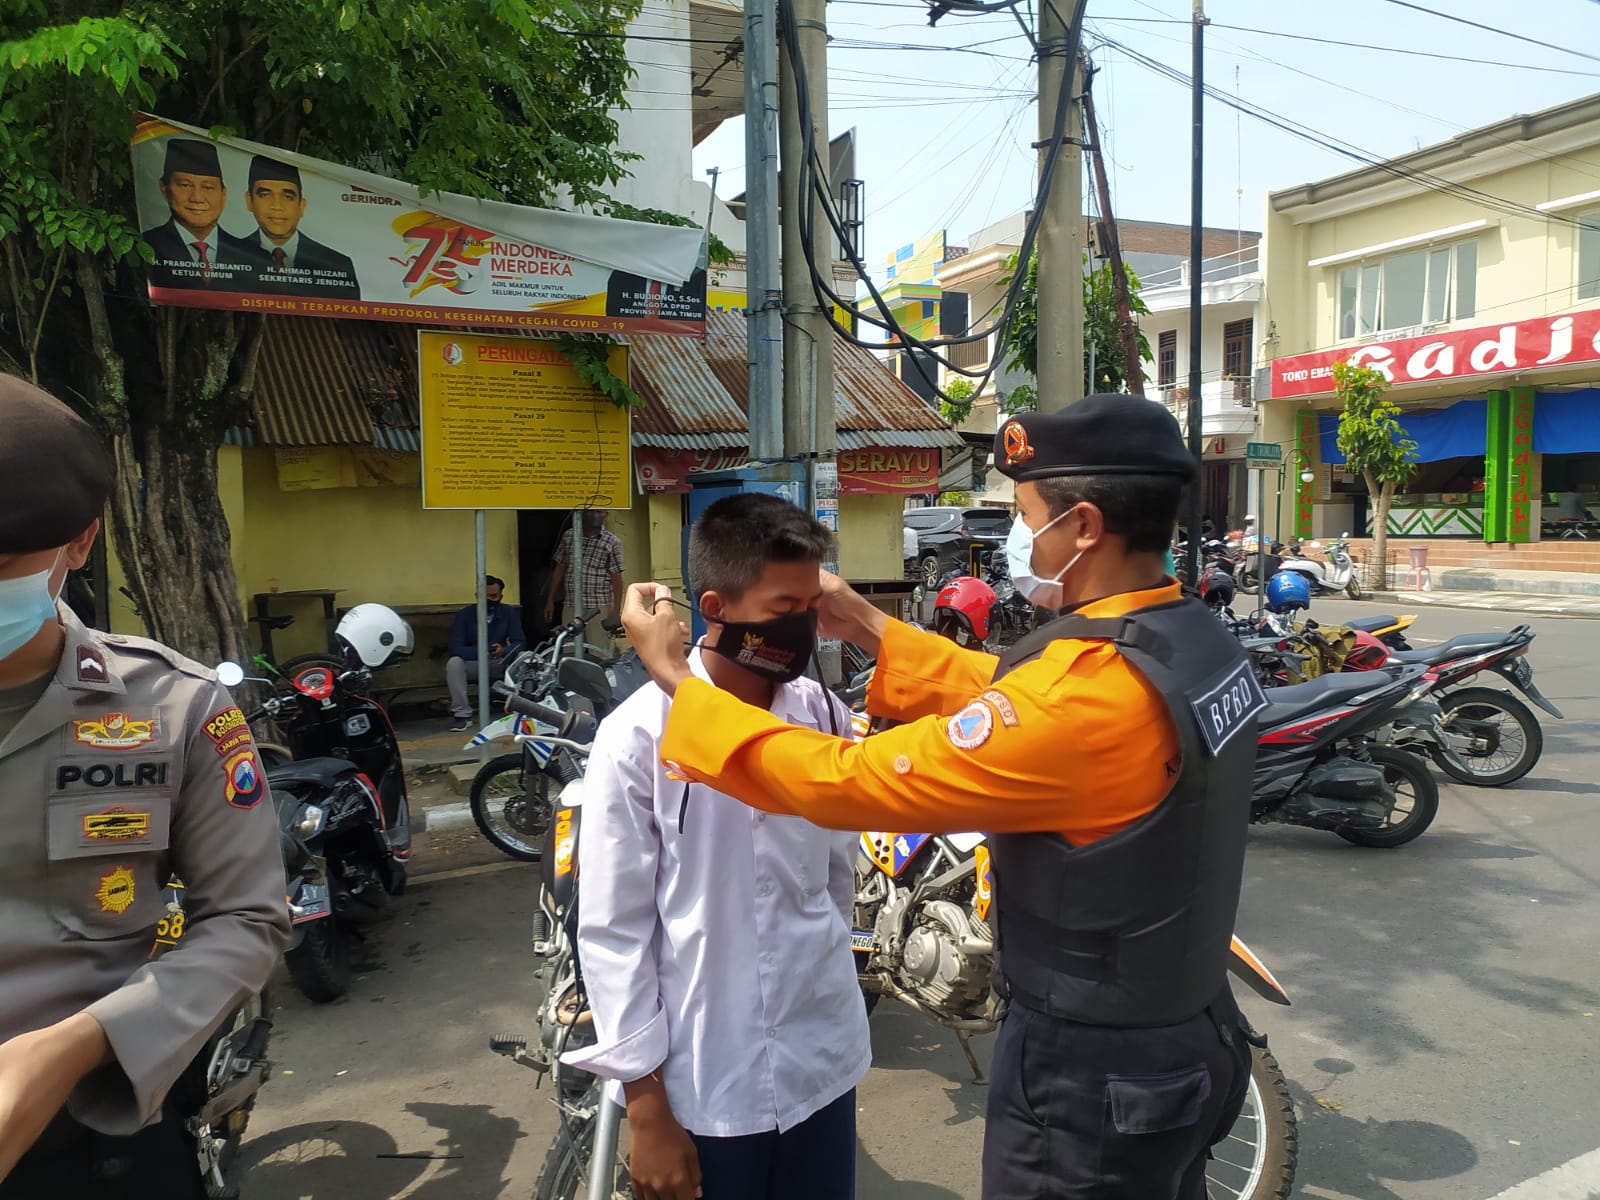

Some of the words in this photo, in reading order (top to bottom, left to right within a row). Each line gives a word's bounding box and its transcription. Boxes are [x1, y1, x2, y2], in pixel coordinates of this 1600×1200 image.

[341, 193, 402, 207] GERINDRA
[490, 241, 587, 263] INDONE
[163, 259, 207, 269] PRABOWO
[208, 262, 253, 272] SUBIANTO
[278, 267, 311, 276] AHMAD
[313, 269, 347, 278] MUZANI
[490, 258, 573, 277] MERDEKA
[172, 269, 202, 277] KETUA
[204, 271, 233, 279] UMUM
[258, 274, 313, 285] SEKRETARIS
[315, 278, 356, 288] JENDRAL
[491, 289, 522, 297] SELURUH
[508, 282, 540, 290] MAKMUR
[622, 291, 632, 299] H.
[619, 308, 655, 316] PROVINSI
[632, 301, 669, 309] ANGGOTA
[242, 298, 296, 310] DISIPLIN
[301, 302, 368, 314] TERAPKAN
[373, 307, 439, 320] PROTOKOL
[444, 311, 513, 324] KESEHATAN
[518, 316, 558, 327] CEGAH
[563, 318, 598, 329] COVID
[612, 321, 625, 330] 19
[477, 345, 572, 363] PERINGATA
[1347, 316, 1600, 382] Gadj
[512, 369, 535, 377] Pasal
[1281, 368, 1309, 383] TOKO
[840, 451, 931, 473] SERAYU
[1209, 676, 1253, 737] BPBD
[206, 708, 245, 735] POLRE
[57, 762, 168, 790] POLRI
